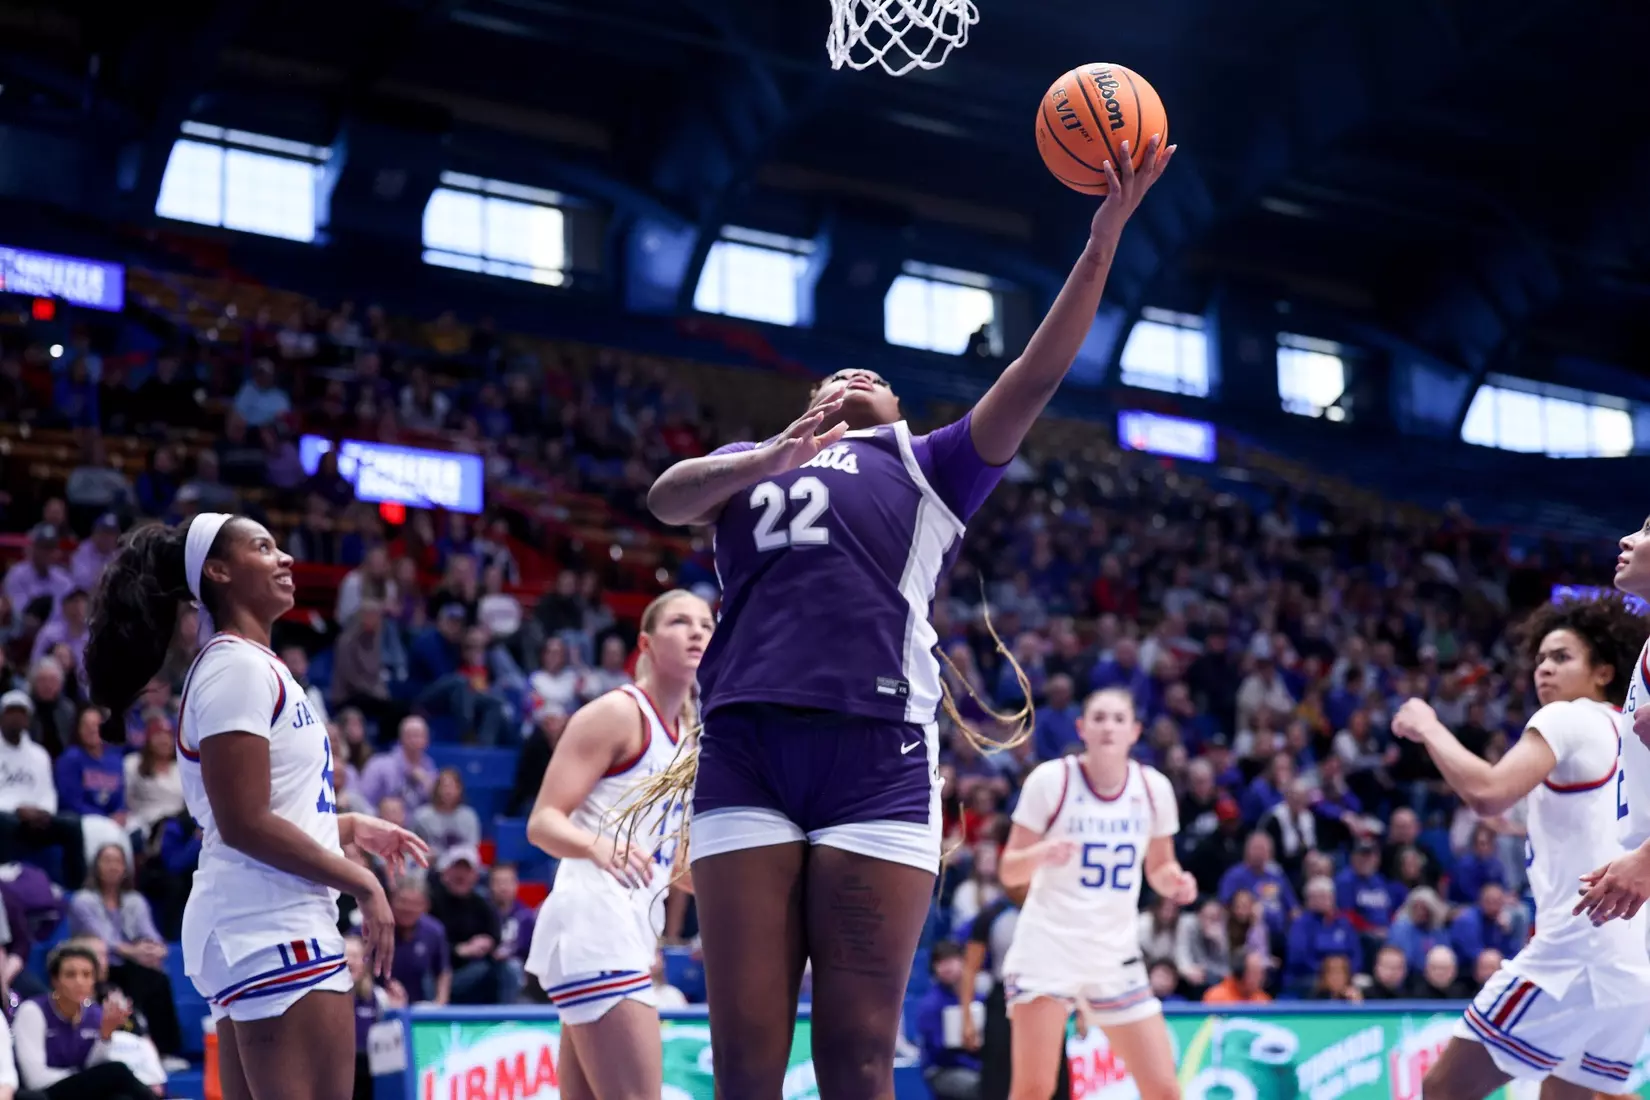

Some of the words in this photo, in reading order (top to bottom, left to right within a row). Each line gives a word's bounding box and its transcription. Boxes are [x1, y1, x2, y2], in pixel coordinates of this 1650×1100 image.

[800, 444, 859, 474] ats
[749, 476, 829, 552] 22
[1081, 843, 1135, 890] 52
[422, 1045, 562, 1100] LIBMA
